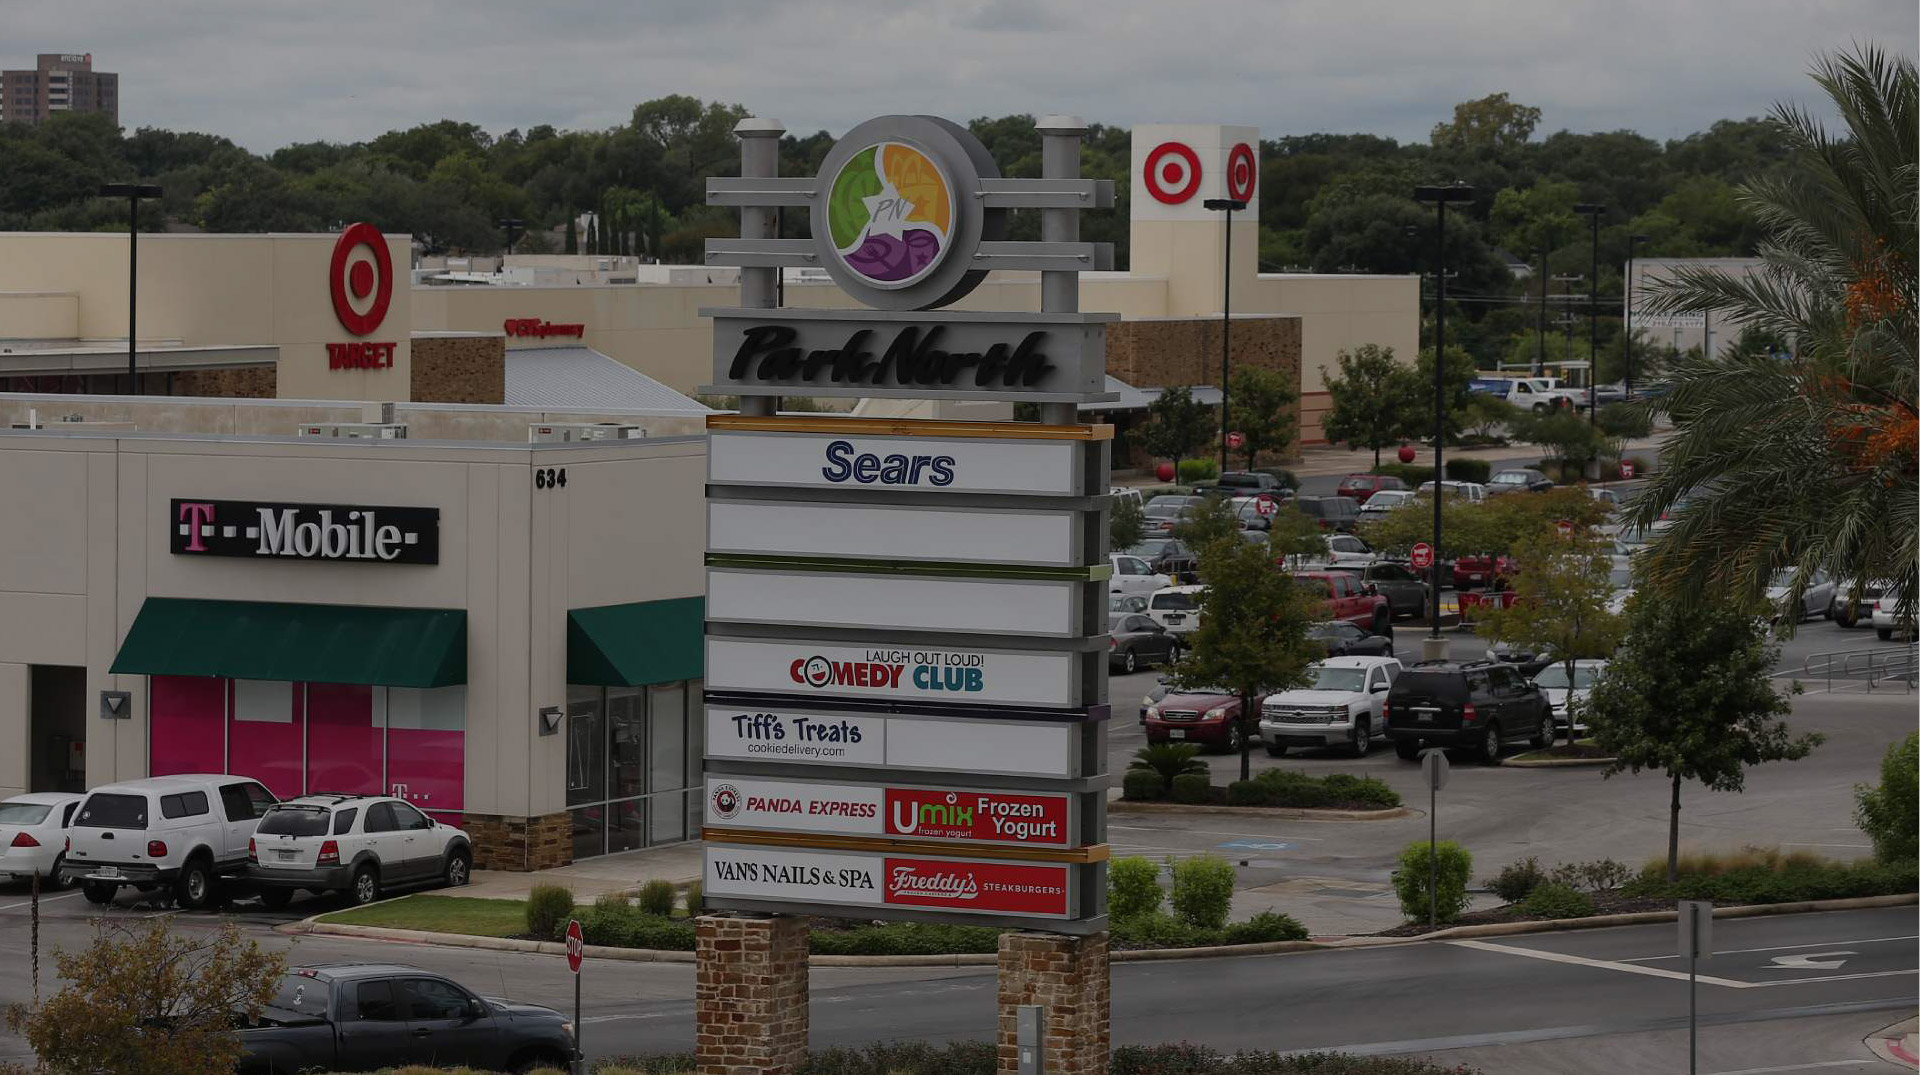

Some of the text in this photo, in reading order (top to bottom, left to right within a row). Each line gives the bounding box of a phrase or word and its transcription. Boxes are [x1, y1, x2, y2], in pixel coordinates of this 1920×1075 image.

[872, 198, 908, 223] PN
[325, 342, 397, 370] TARGET
[822, 440, 956, 487] Sears
[536, 468, 567, 489] 634
[866, 650, 984, 667] LAUGH OUT LOUD!
[790, 656, 984, 691] COMEDY CLUB
[732, 713, 861, 743] Tiff's Treats
[748, 743, 845, 758] cookiedelivery.com
[746, 797, 803, 814] PANDA
[808, 800, 877, 818] EXPRESS
[893, 792, 973, 834] Umix
[978, 797, 1044, 818] Frozen
[917, 826, 972, 839] frozen yogurt
[991, 816, 1057, 840] Yogurt
[714, 861, 874, 889] VAN'S NAILS & SPA
[889, 866, 978, 898] Freddy's
[983, 882, 1062, 895] STEAKBURGERS
[567, 935, 582, 958] STOP
